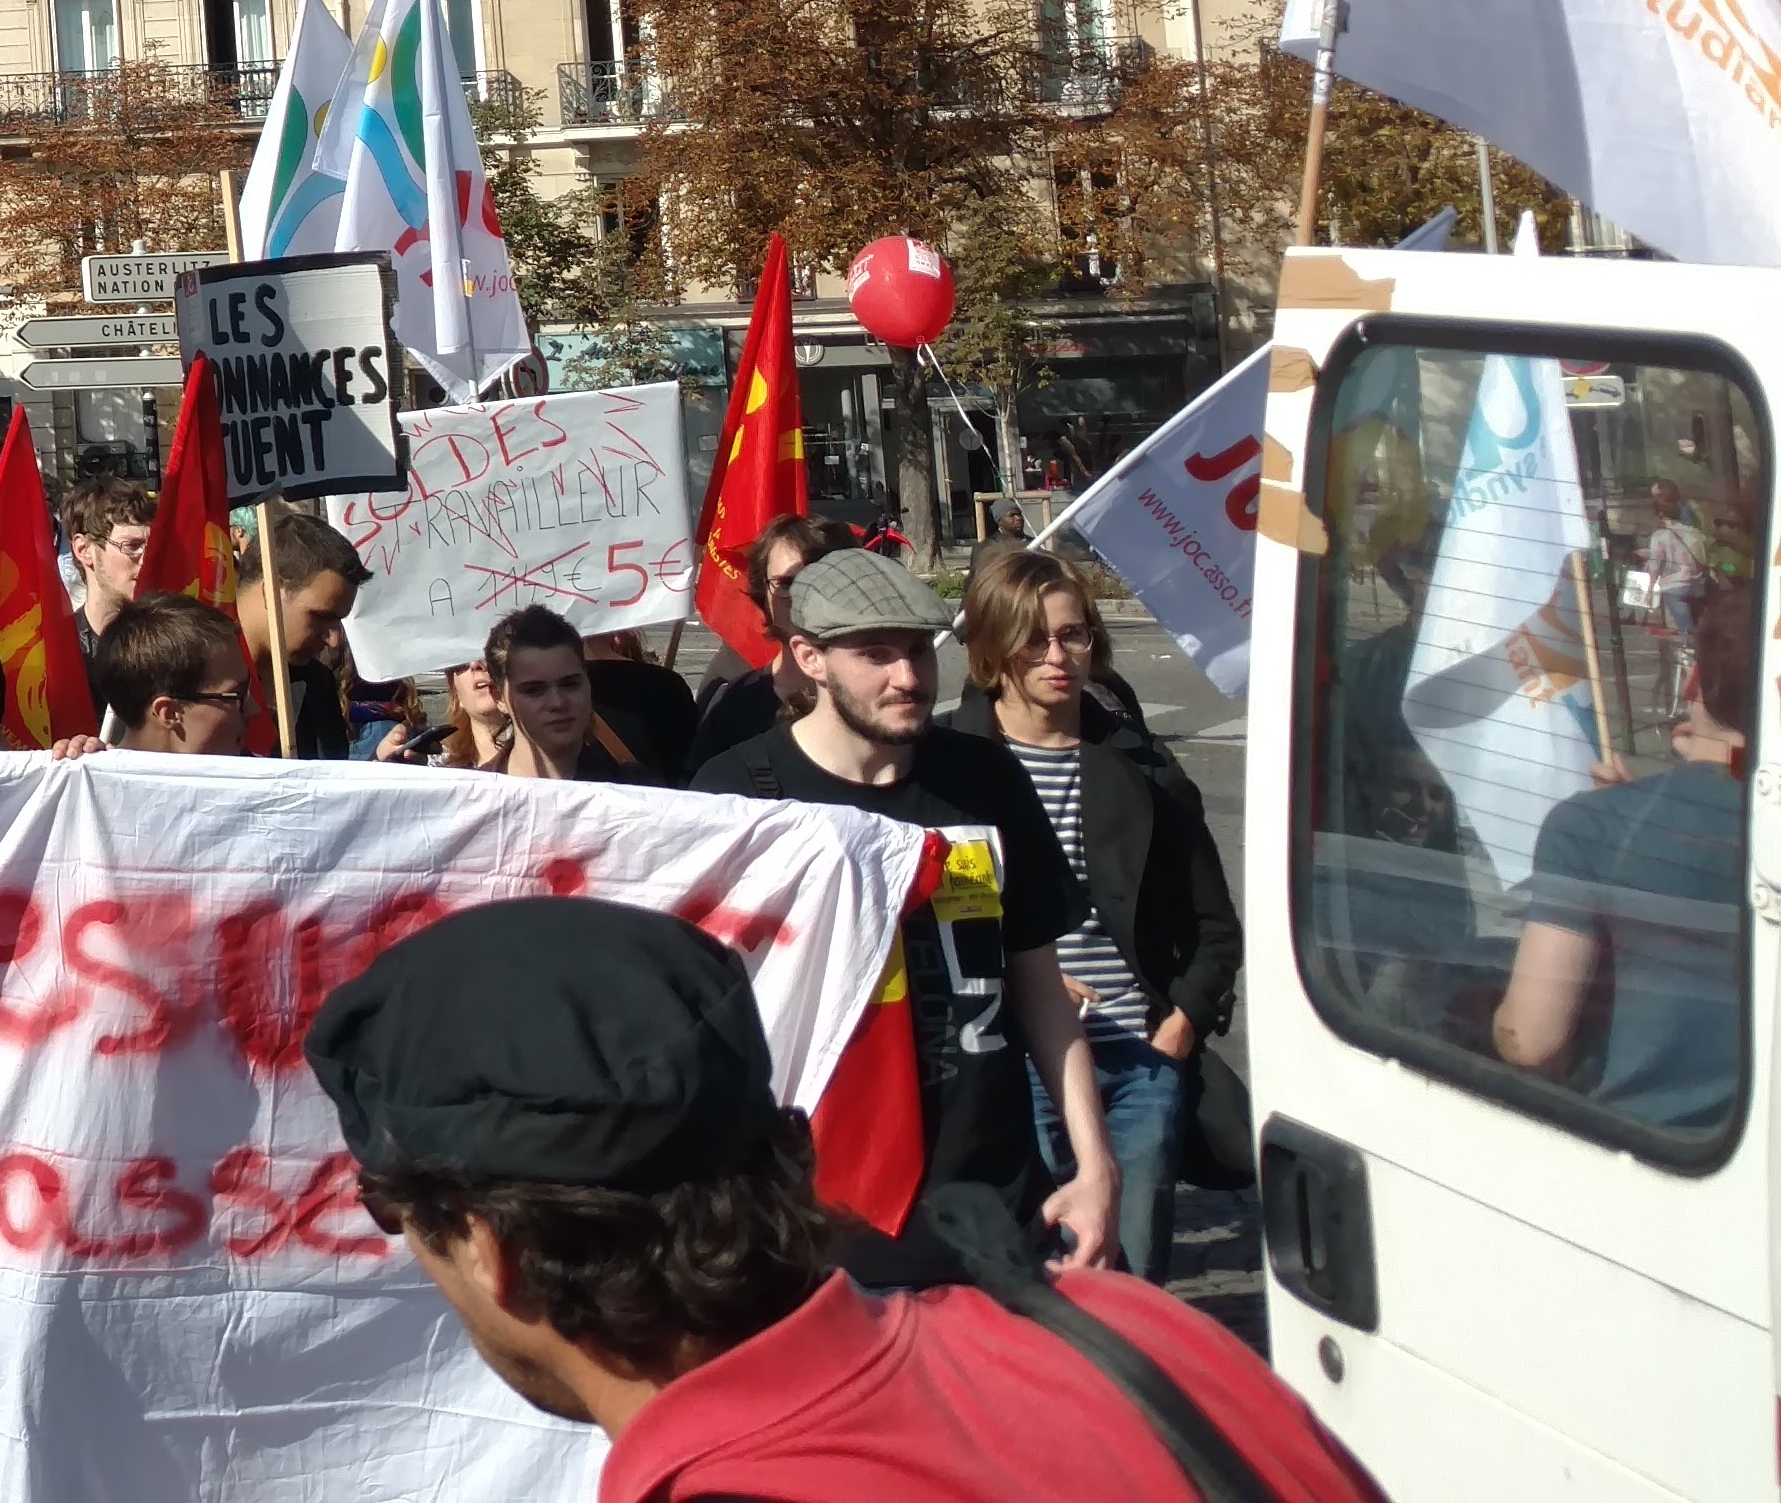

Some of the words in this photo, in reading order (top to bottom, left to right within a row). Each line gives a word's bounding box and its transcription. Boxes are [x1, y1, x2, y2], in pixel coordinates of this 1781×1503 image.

[97, 278, 165, 294] NATION
[209, 283, 285, 348] LES
[101, 320, 177, 337] CHÂTEL
